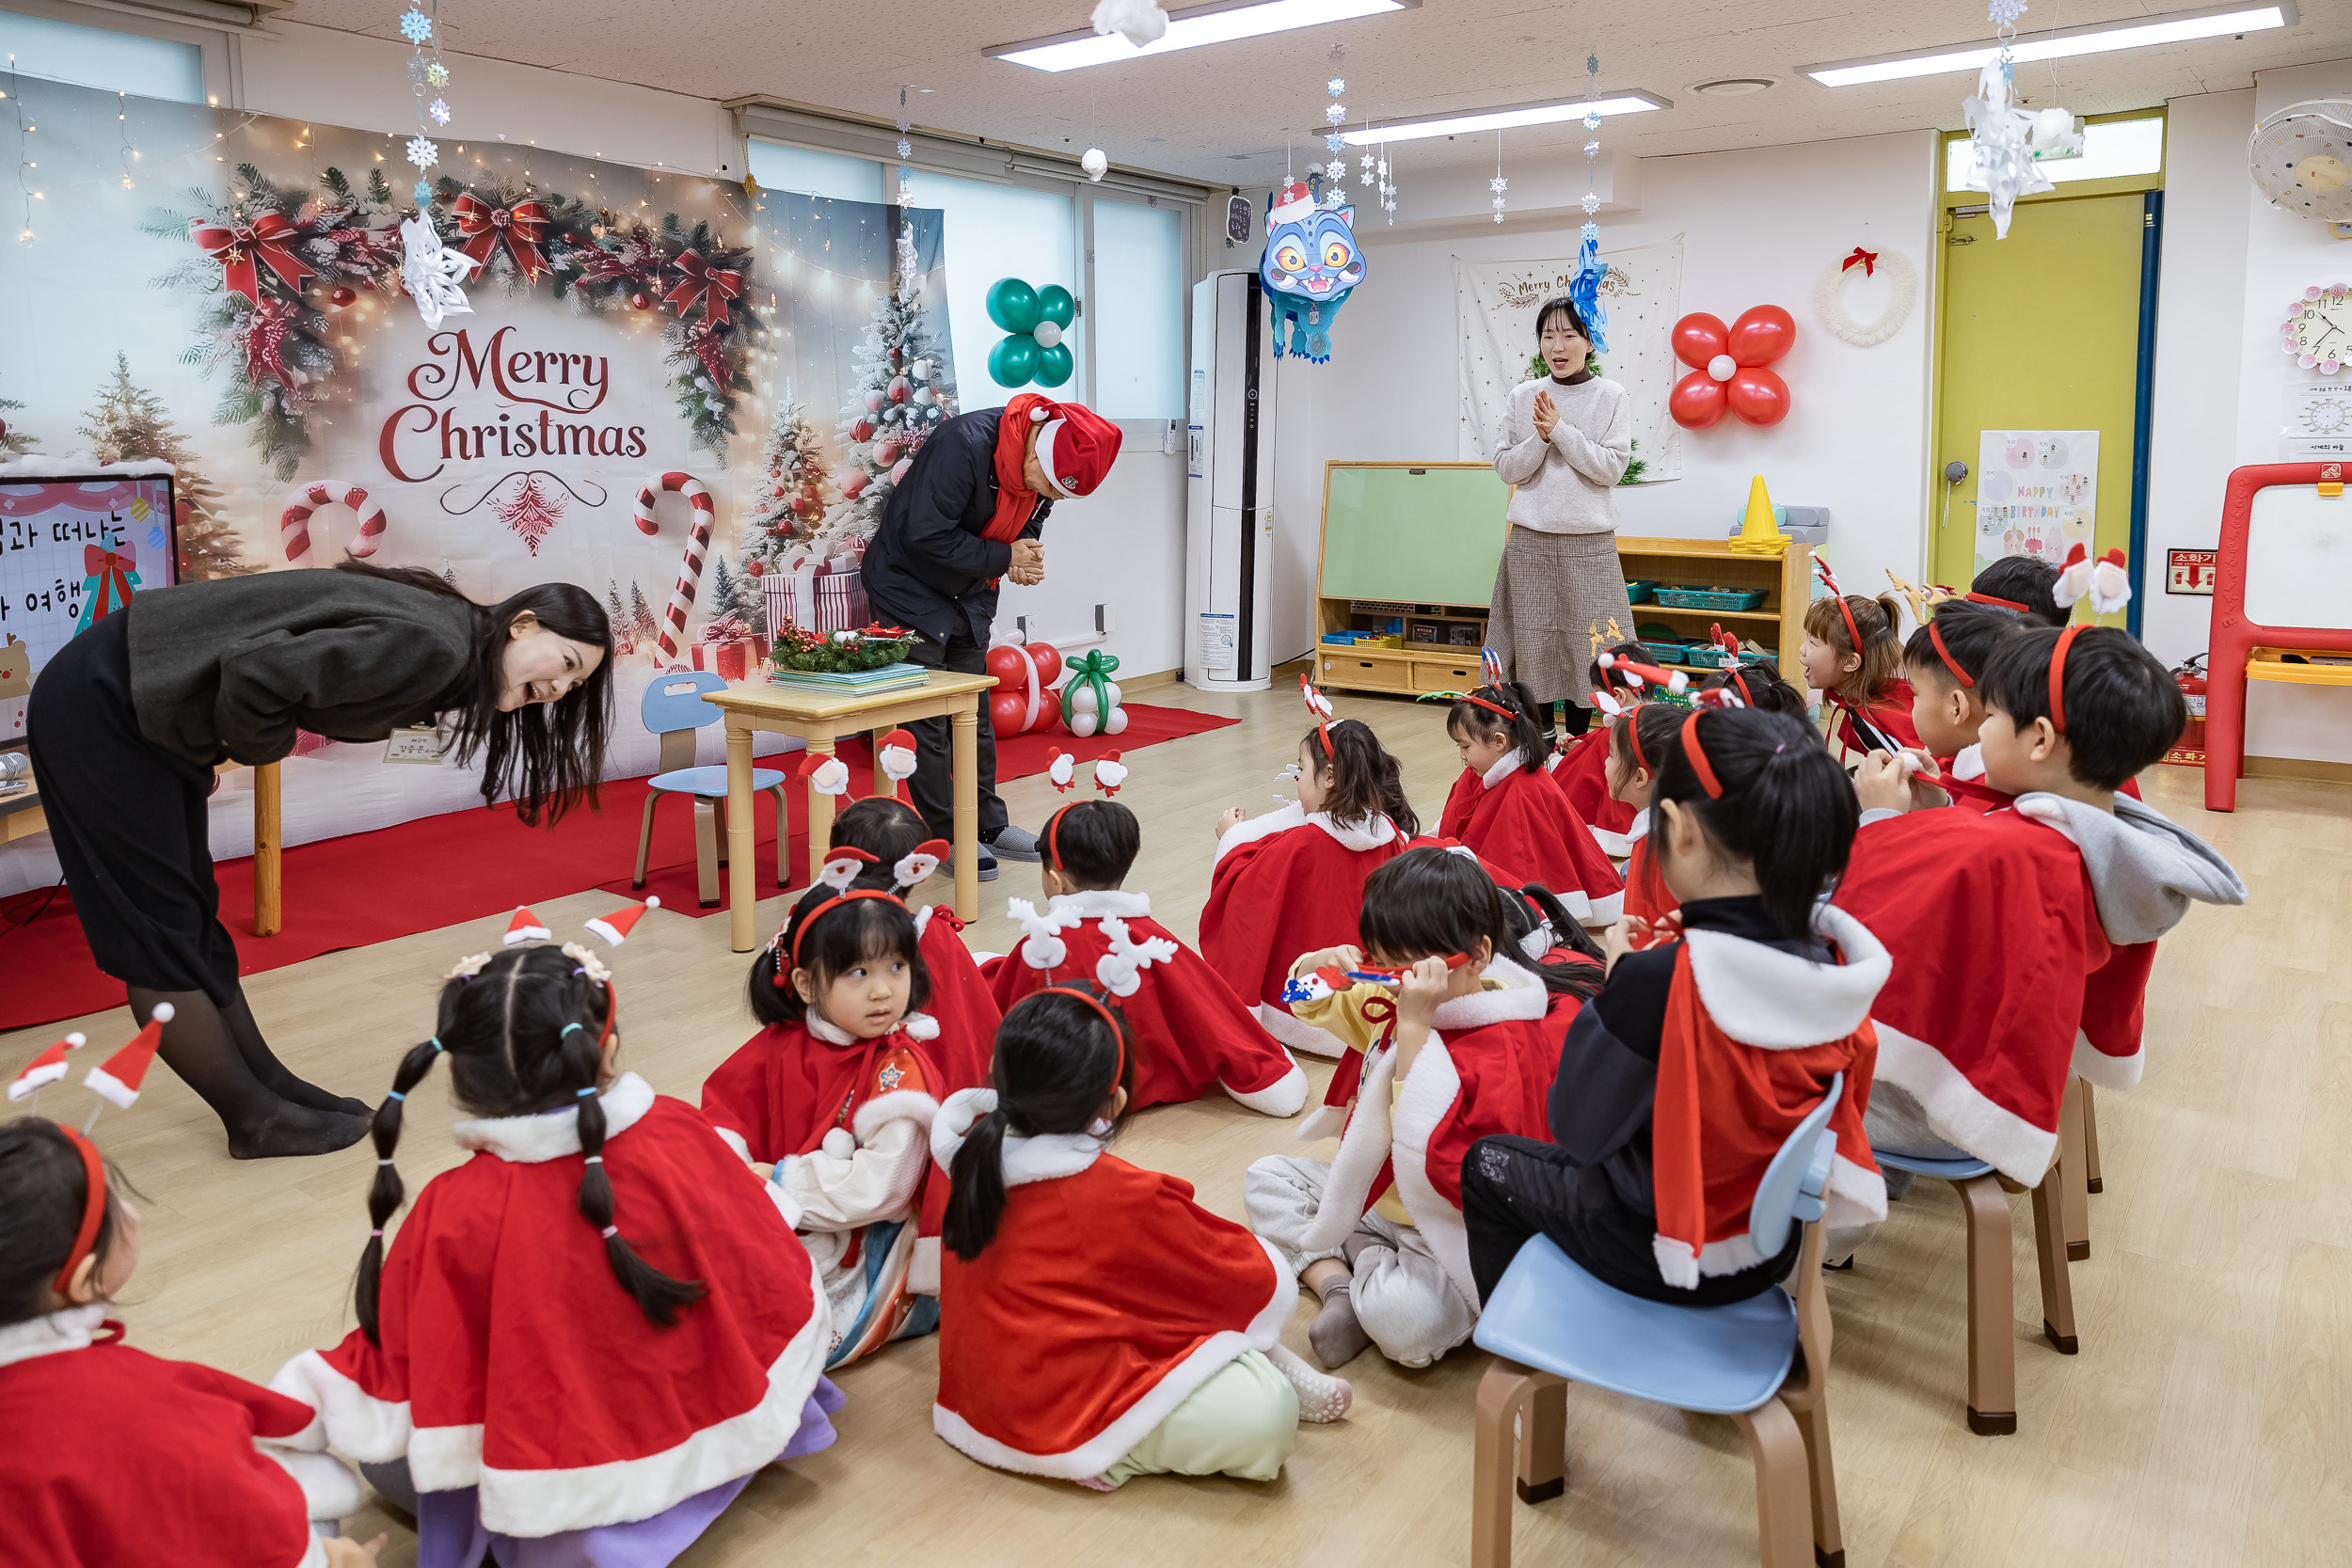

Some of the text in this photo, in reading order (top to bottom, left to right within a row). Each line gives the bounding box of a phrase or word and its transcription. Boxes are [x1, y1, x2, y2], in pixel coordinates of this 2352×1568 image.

[1518, 280, 1550, 295] Merry
[2318, 299, 2327, 309] 11
[2331, 296, 2344, 306] 12
[2304, 309, 2315, 320] 10
[2298, 323, 2307, 333] 9
[2299, 336, 2308, 346] 8
[2313, 345, 2321, 356] 7
[2328, 349, 2336, 358] 6
[407, 326, 609, 414] Merry
[379, 404, 647, 483] Christmas
[2018, 486, 2054, 499] HAPPY
[2010, 505, 2060, 518] BIRTHDAY
[0, 511, 126, 556] 과 떠나는
[2173, 553, 2217, 563] 소화기
[26, 578, 81, 618] 여행
